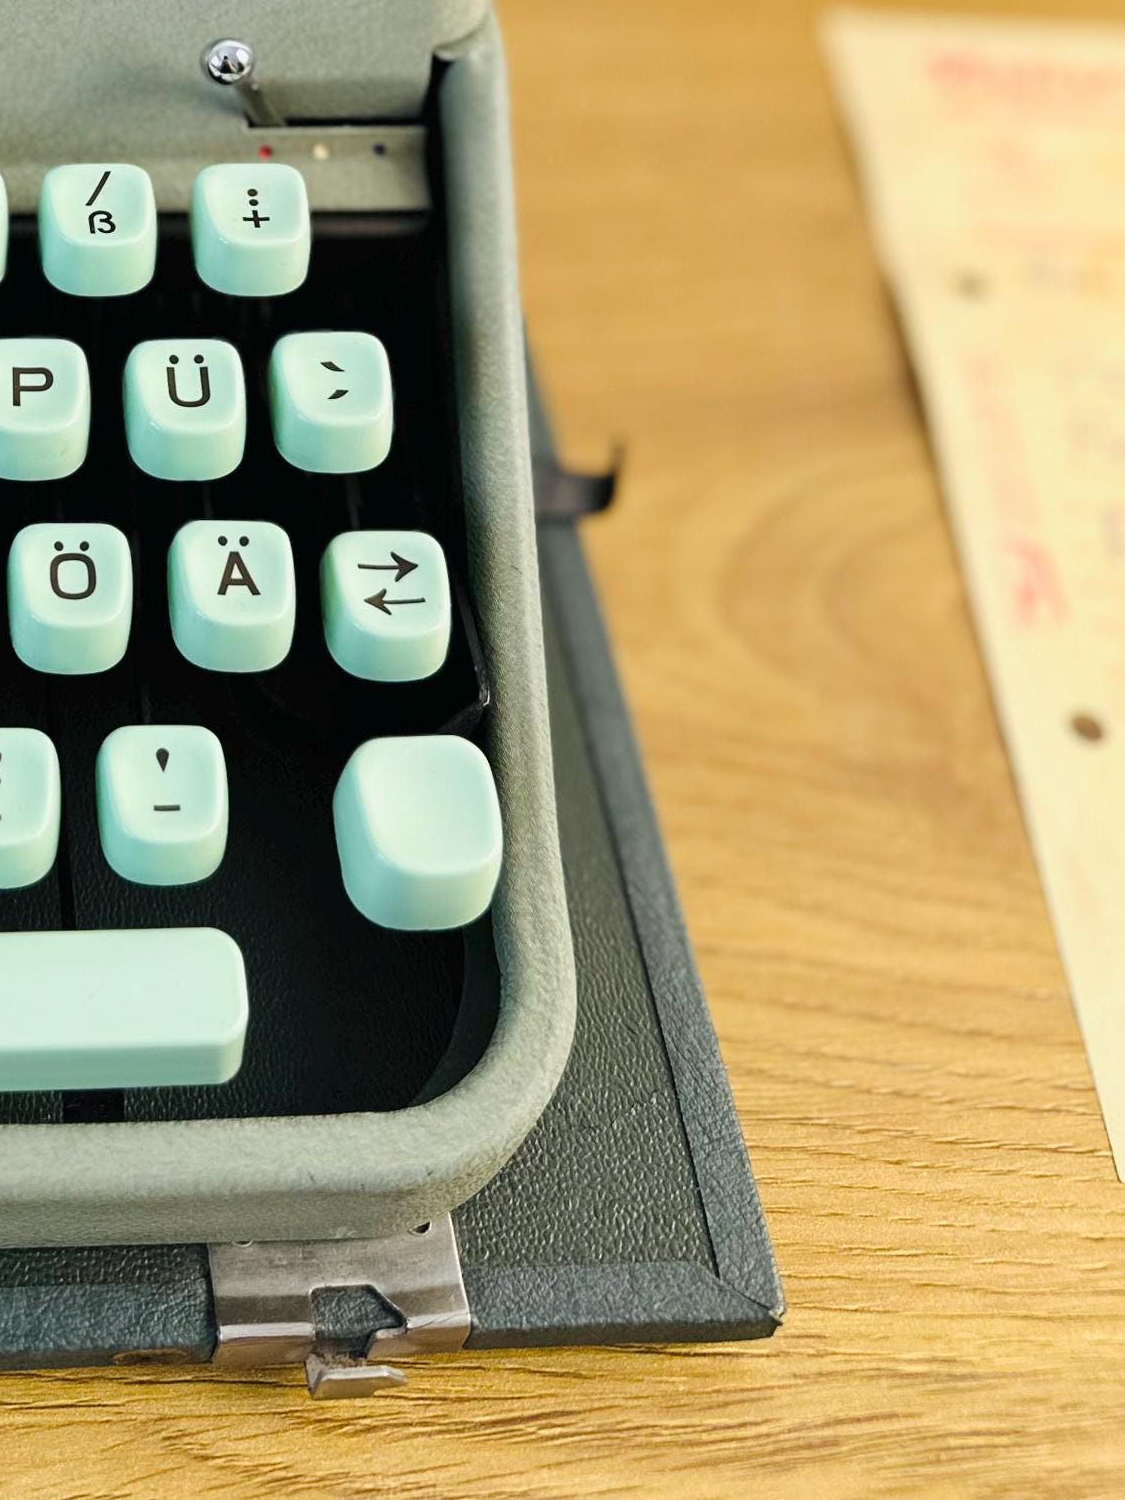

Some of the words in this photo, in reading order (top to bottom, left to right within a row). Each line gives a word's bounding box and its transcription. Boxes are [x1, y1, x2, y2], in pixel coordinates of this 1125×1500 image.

[85, 170, 111, 207] /
[242, 209, 271, 229] +
[12, 366, 54, 407] P
[166, 354, 211, 408] Ü
[49, 540, 97, 601] Ö
[217, 535, 261, 596] Ä
